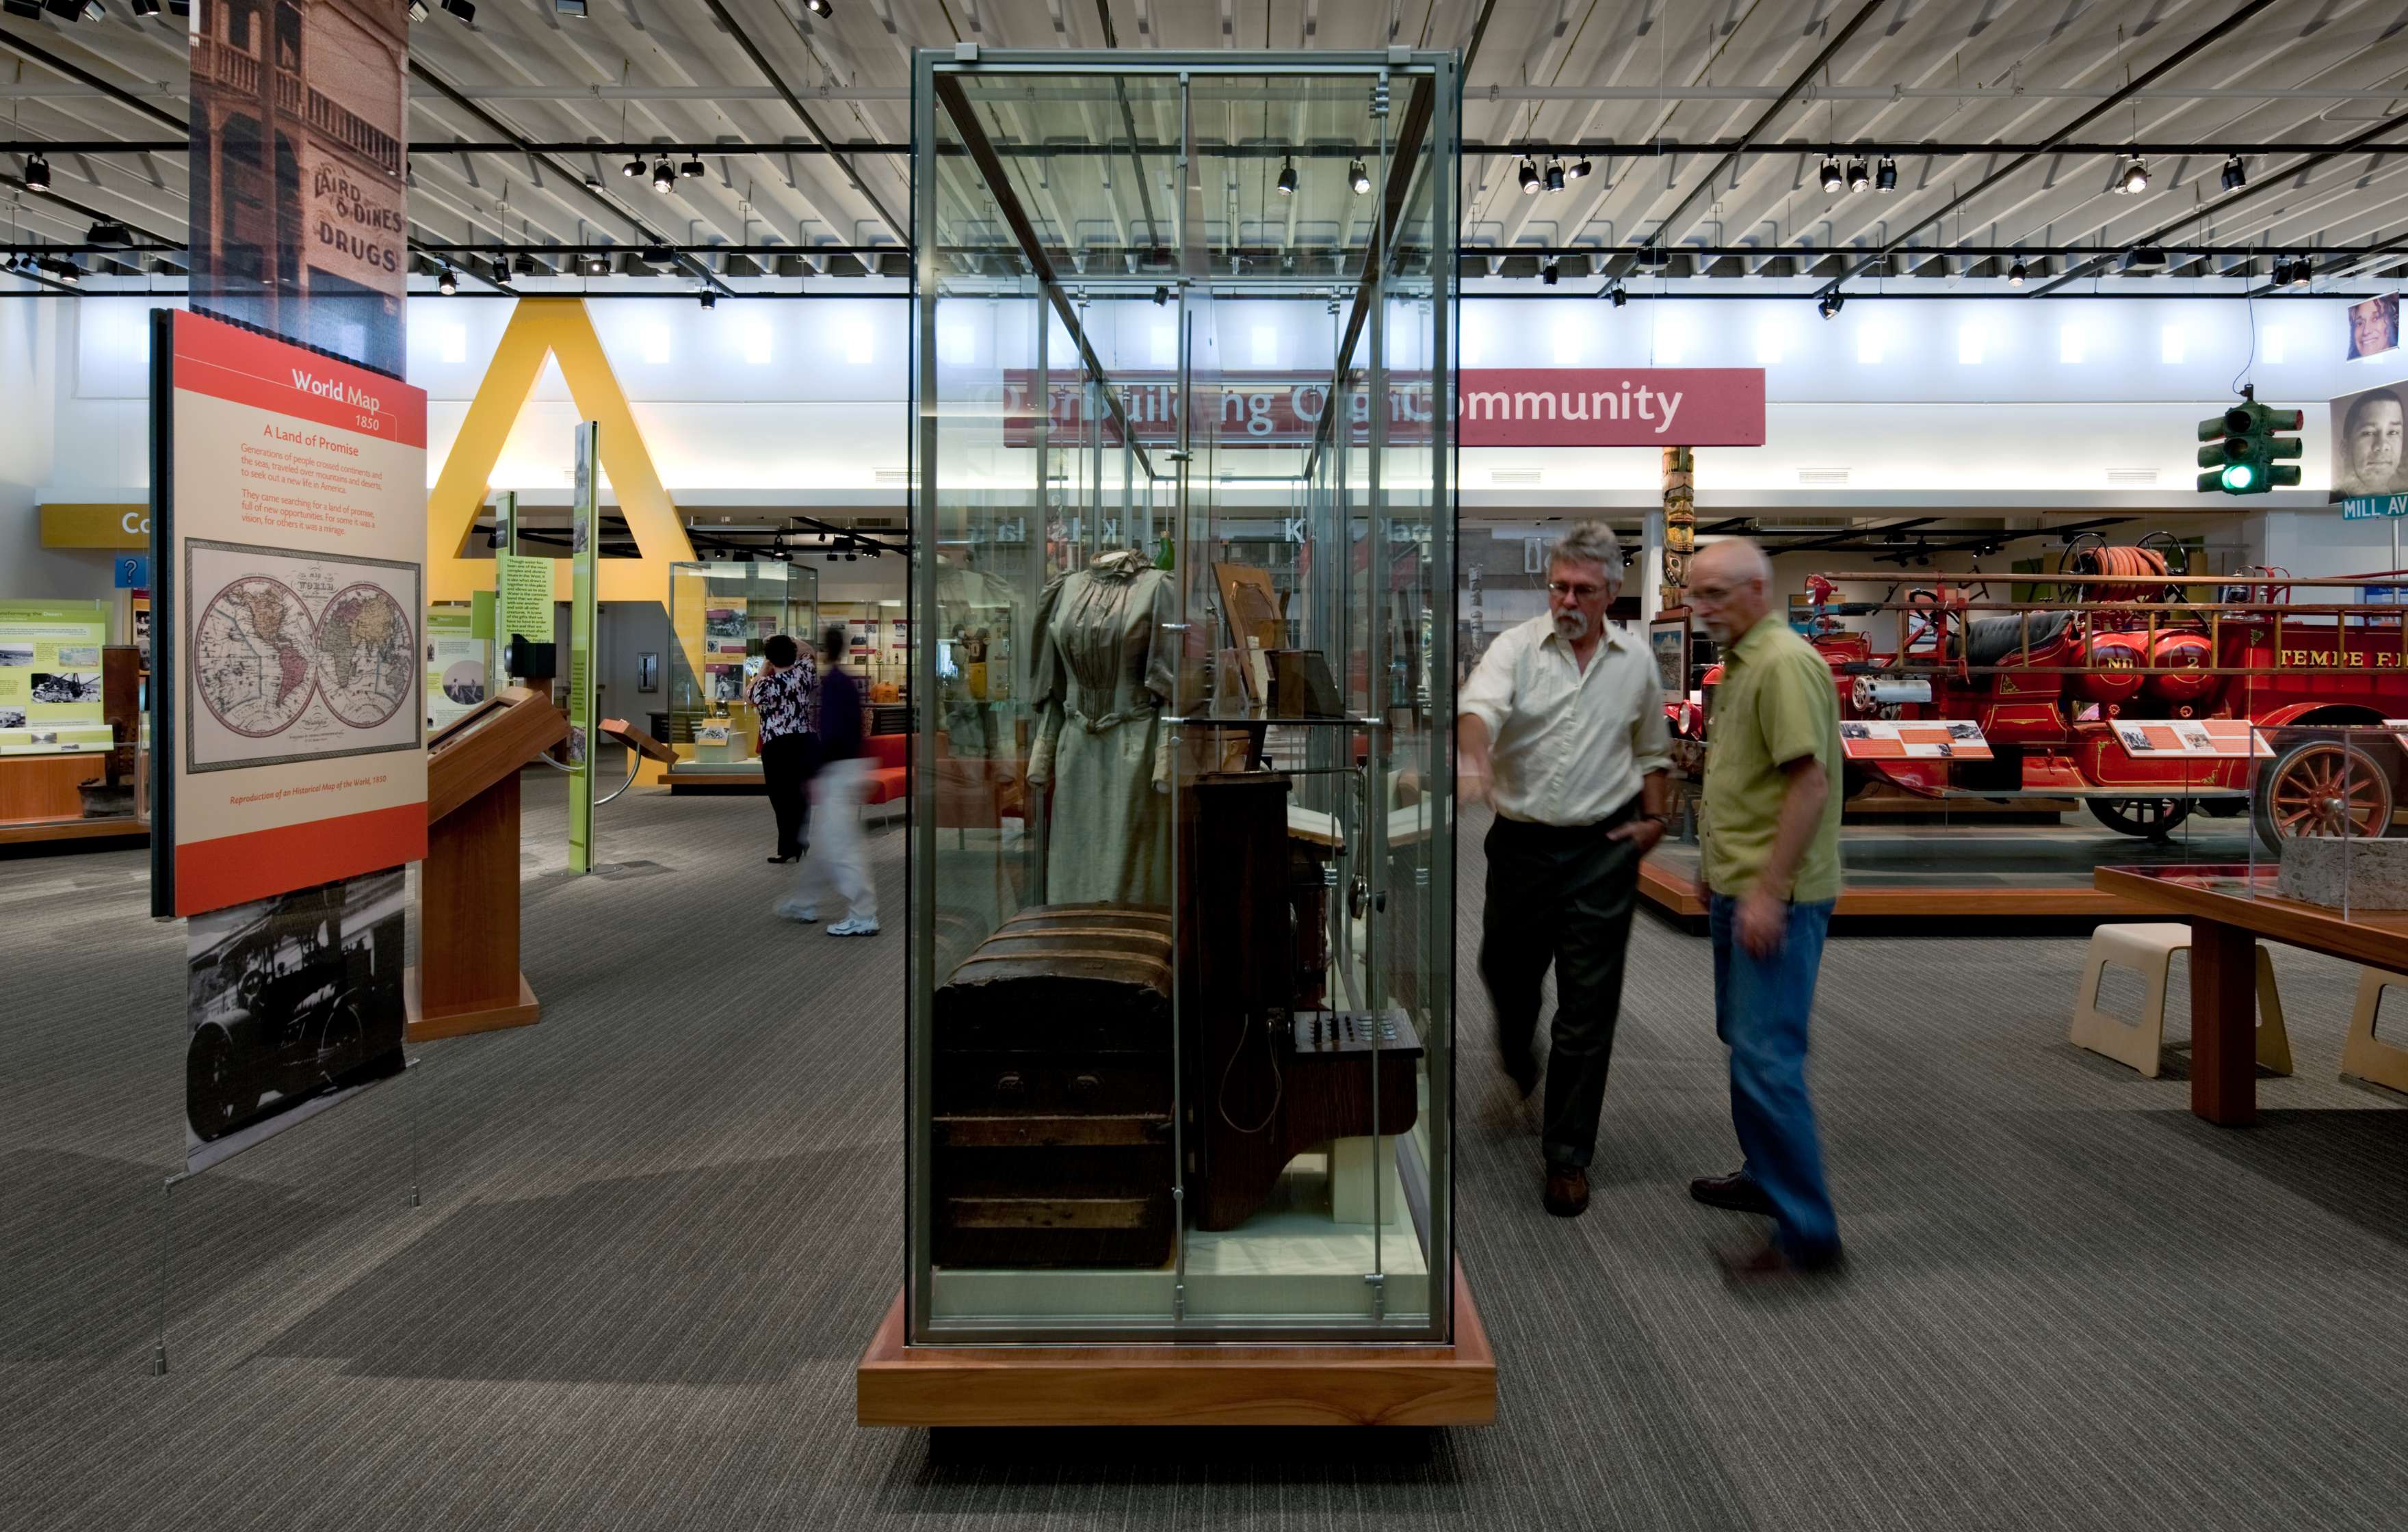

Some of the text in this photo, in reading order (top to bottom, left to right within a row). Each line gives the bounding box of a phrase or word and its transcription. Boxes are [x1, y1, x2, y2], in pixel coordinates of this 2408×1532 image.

[320, 220, 395, 272] DRUGS
[292, 369, 380, 415] World Map
[356, 415, 379, 430] 1850
[264, 425, 359, 456] A Land of Promise
[241, 443, 283, 459] Generations
[293, 456, 315, 466] people
[317, 460, 339, 471] crossed
[341, 465, 370, 477] continents
[241, 455, 252, 465] the
[254, 460, 270, 470] seas,
[272, 462, 298, 474] traveled
[317, 472, 347, 483] mountains
[241, 488, 259, 501] They
[261, 494, 279, 503] came
[281, 497, 311, 510] searching
[313, 500, 322, 509] for
[329, 503, 341, 512] land
[241, 501, 252, 510] full
[254, 503, 263, 512] of
[264, 506, 278, 514] new
[326, 514, 335, 522] For
[2344, 496, 2408, 518] MILL AV
[241, 514, 262, 525] vision,
[265, 516, 275, 525] for
[277, 520, 298, 528] others
[2187, 657, 2199, 668] 2
[231, 791, 274, 805] Reproduction
[276, 789, 283, 800] of
[293, 785, 321, 795] Historical
[322, 783, 335, 793] Map
[337, 781, 343, 790] of
